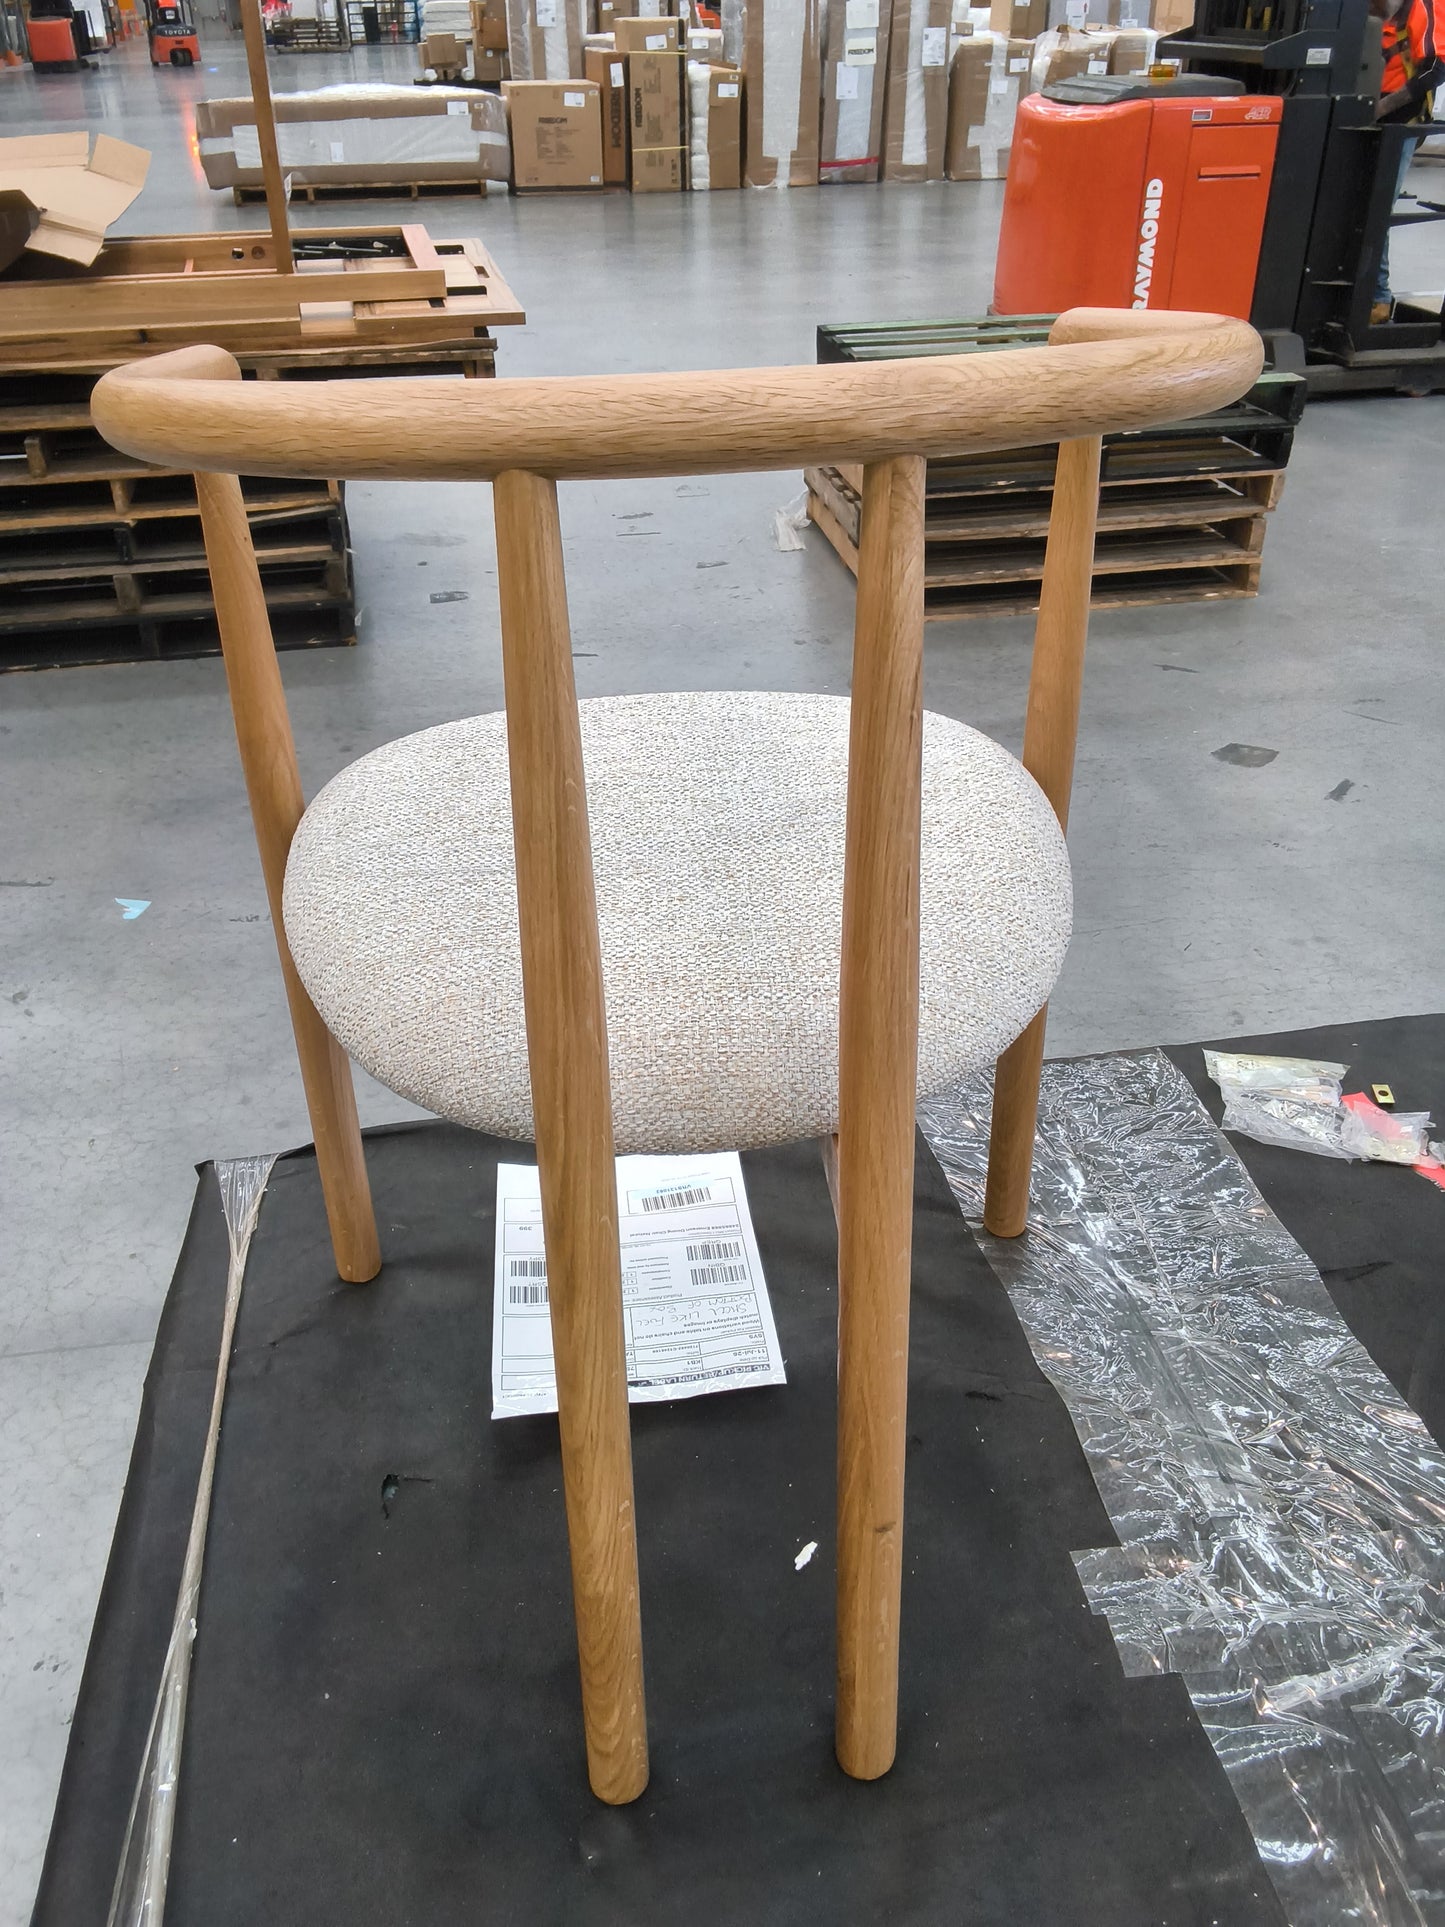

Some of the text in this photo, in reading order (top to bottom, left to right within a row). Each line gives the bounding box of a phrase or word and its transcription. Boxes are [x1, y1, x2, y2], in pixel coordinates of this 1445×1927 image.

[847, 47, 875, 56] FREEDOM
[634, 87, 643, 128] FREEDOM
[538, 116, 568, 124] FREEDOM
[1131, 178, 1163, 309] RAYMOND
[688, 1300, 701, 1309] OF
[670, 1311, 699, 1323] LIKE
[712, 1322, 740, 1330] variations
[649, 1377, 677, 1386] LABEL
